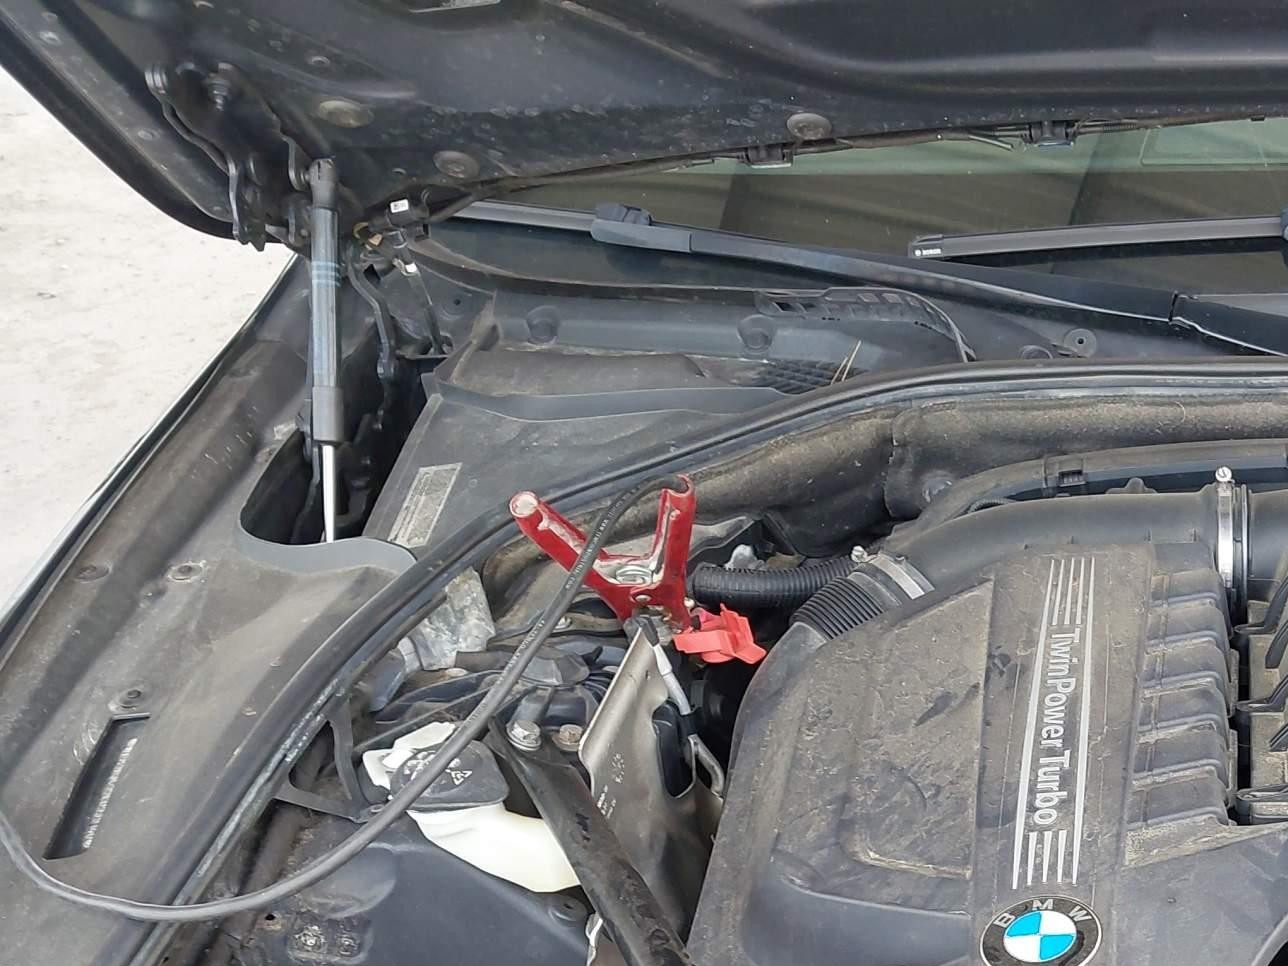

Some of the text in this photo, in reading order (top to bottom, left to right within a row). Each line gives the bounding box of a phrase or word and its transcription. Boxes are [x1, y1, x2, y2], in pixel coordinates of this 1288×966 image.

[1033, 627, 1081, 825] TwinPower Turbo
[993, 898, 1092, 928] BMW
